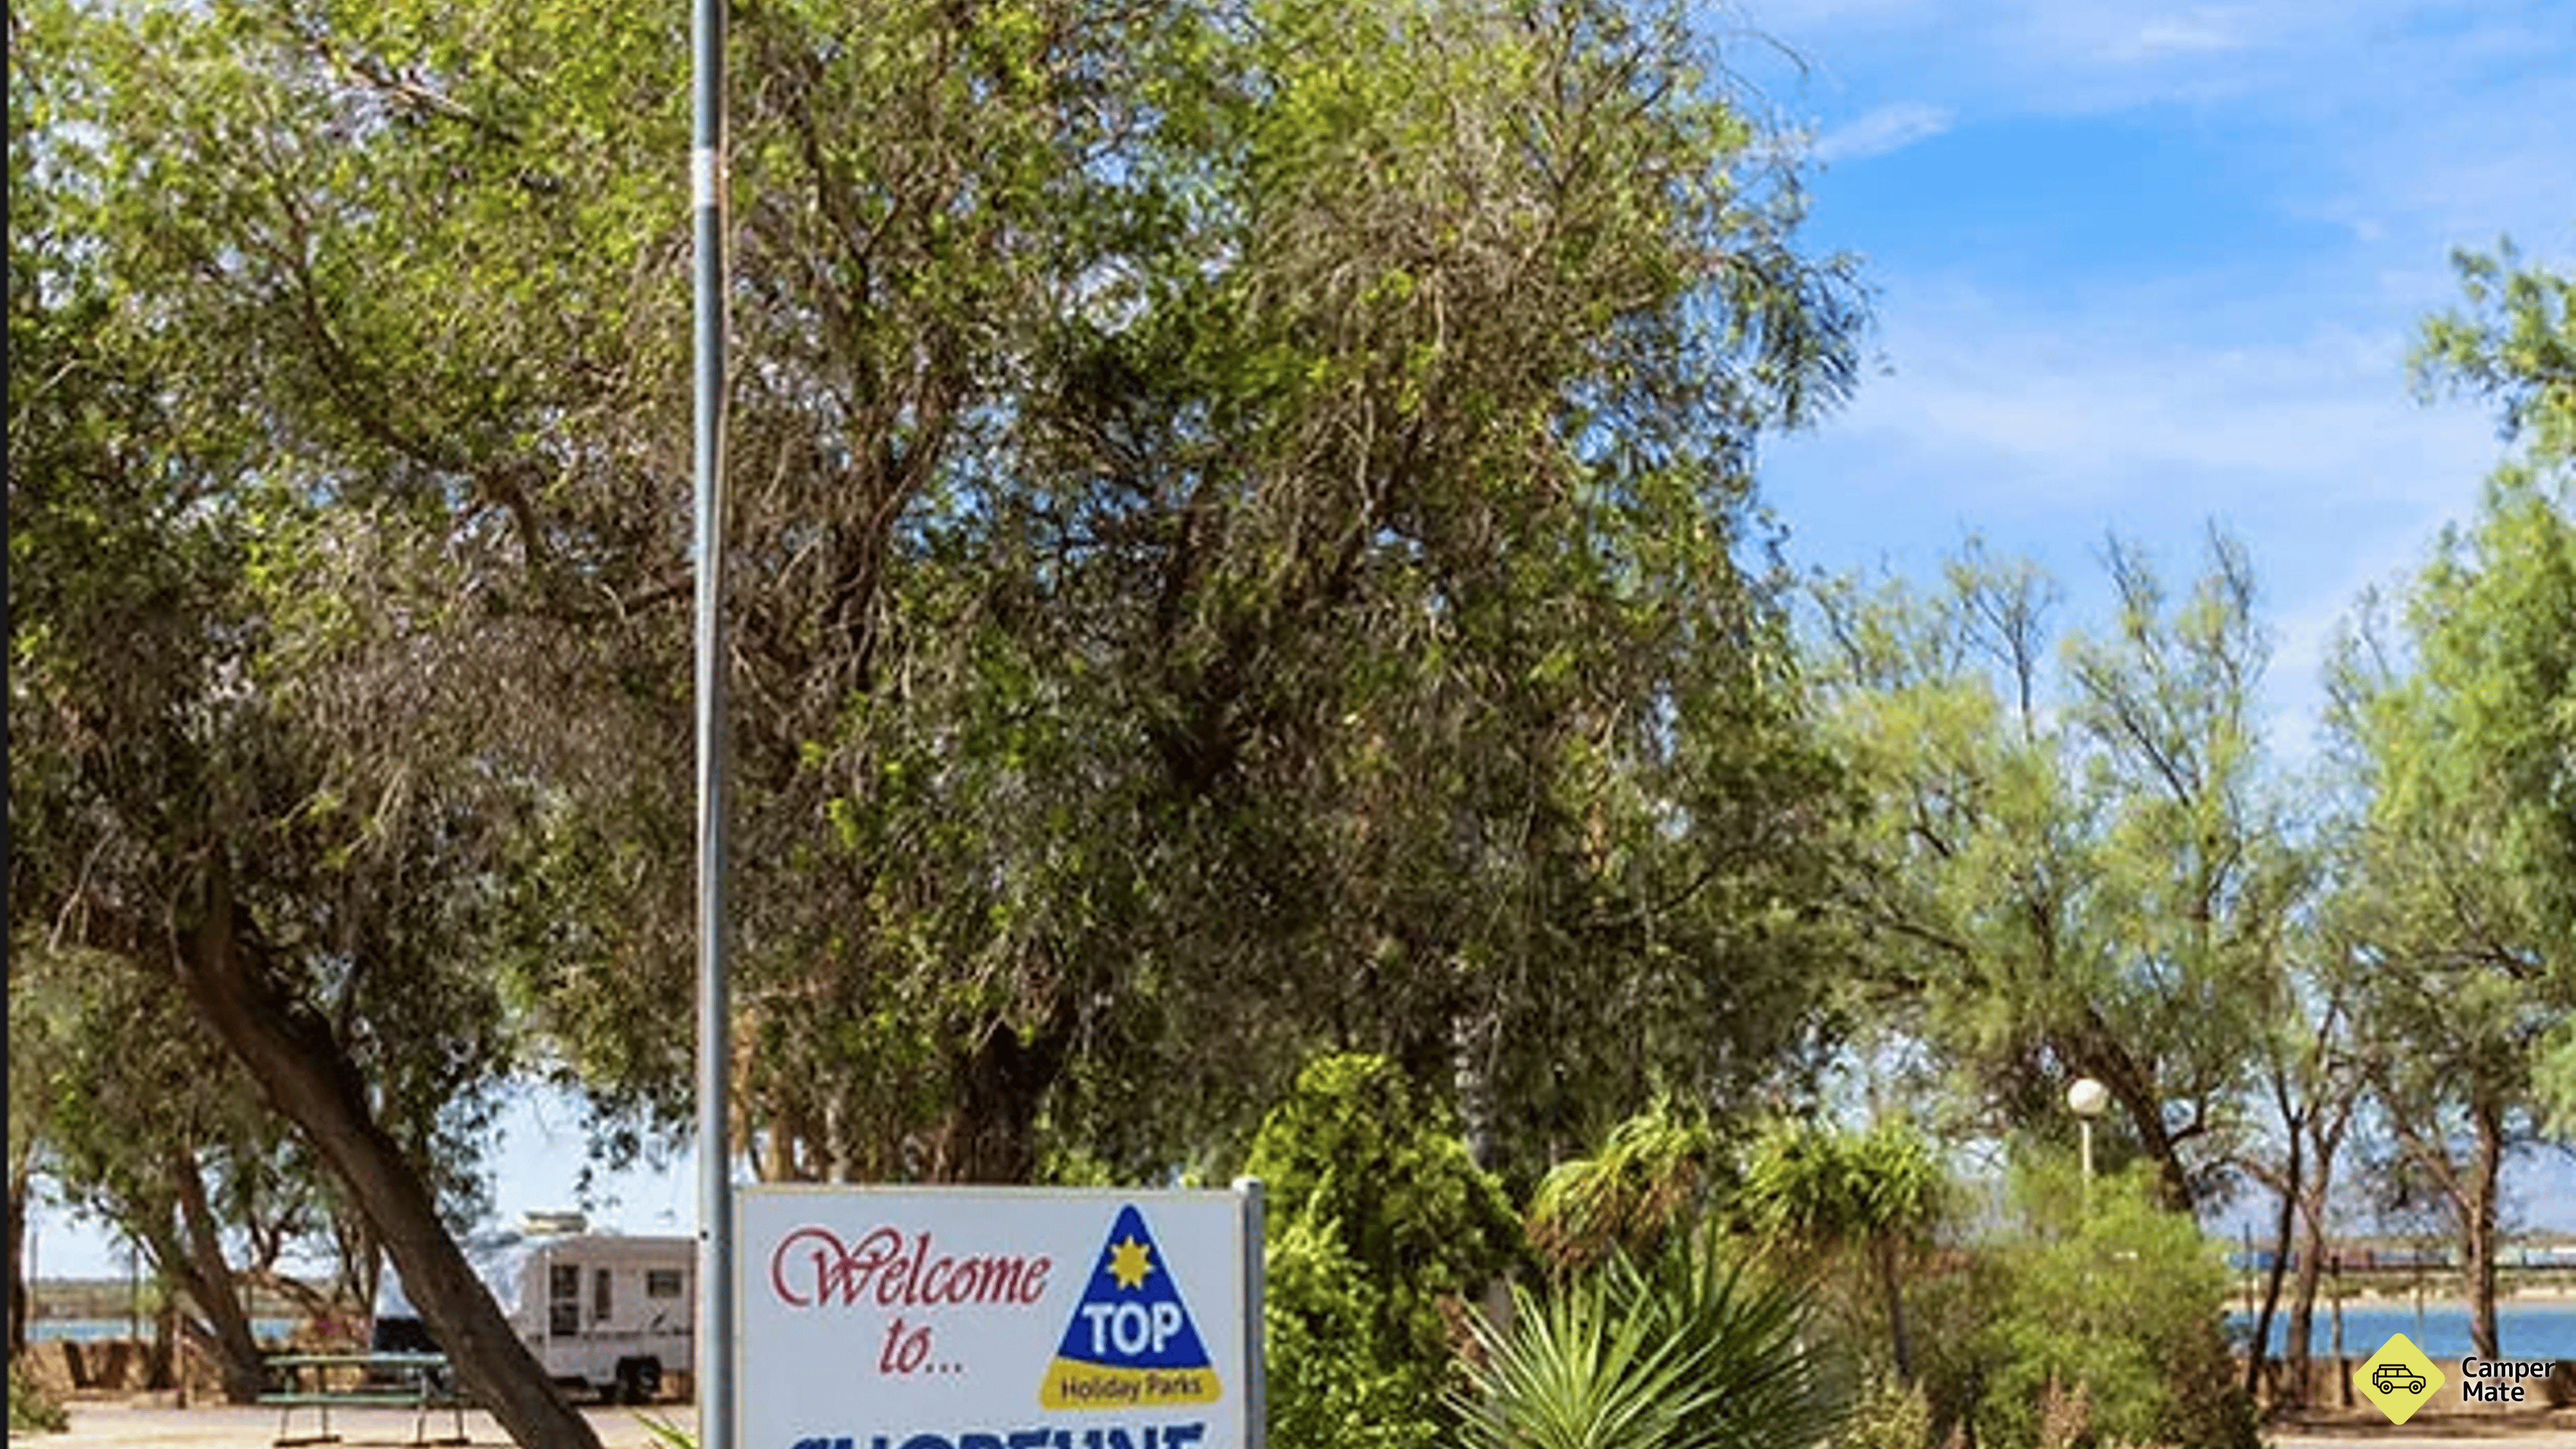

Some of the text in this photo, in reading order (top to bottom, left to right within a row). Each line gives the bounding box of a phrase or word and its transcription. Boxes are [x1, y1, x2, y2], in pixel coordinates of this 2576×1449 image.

[772, 1227, 1052, 1307] Welcome
[878, 1317, 962, 1376] to...
[1083, 1302, 1184, 1355] TOP
[1061, 1372, 1203, 1404] Holiday Parks
